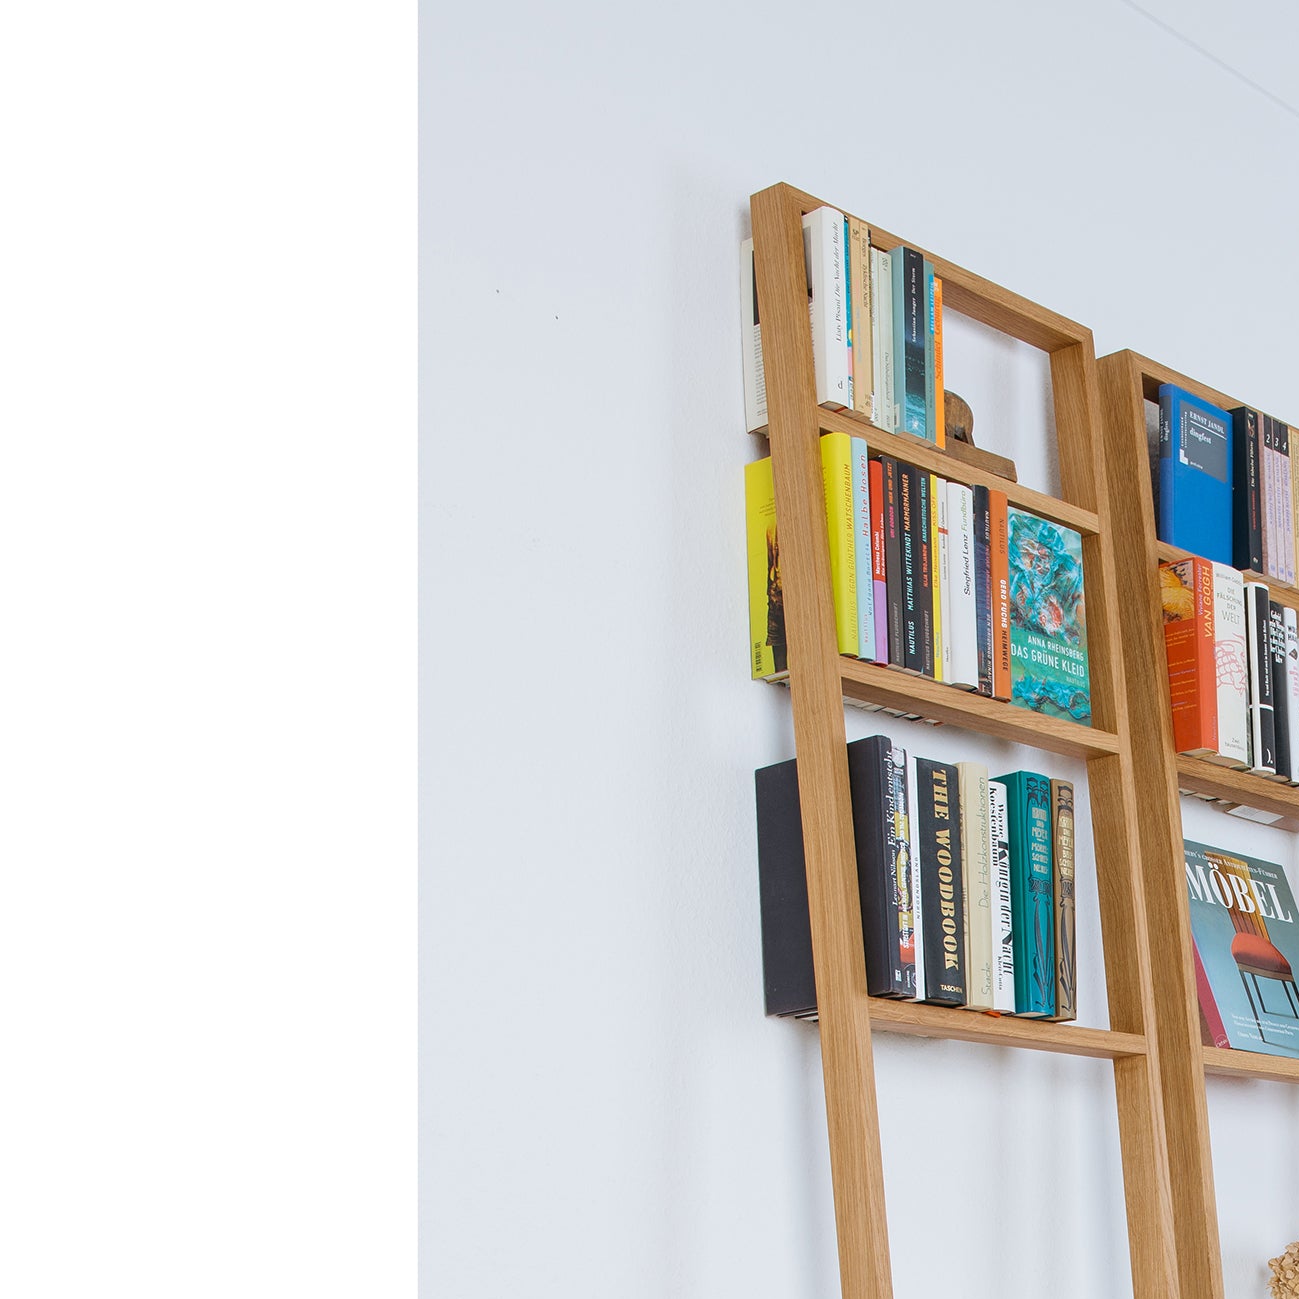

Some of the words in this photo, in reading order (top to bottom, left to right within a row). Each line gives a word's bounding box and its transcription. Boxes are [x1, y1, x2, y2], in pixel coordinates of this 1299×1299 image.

[833, 259, 841, 280] Nacht
[833, 284, 841, 297] Die
[1189, 411, 1207, 425] ERNST
[1207, 420, 1225, 434] JANDL
[1189, 427, 1211, 444] dingfest
[1266, 433, 1271, 443] 2
[1274, 437, 1279, 448] 3
[1282, 442, 1287, 451] 4
[844, 464, 853, 530] WATSCHENBAUM
[902, 474, 912, 531] MARMORMÄNNER
[959, 489, 968, 532] Fundbüro
[861, 499, 870, 537] Halbe
[905, 533, 914, 575] WITTEKINDT
[961, 533, 970, 555] Lenz
[962, 555, 972, 596] Siegfried
[1000, 579, 1008, 600] GERD
[1202, 566, 1211, 606] GOGH
[906, 577, 914, 611] MATTHIAS
[1226, 603, 1236, 611] DER
[1204, 610, 1213, 639] VAN
[1221, 610, 1240, 625] WELT
[908, 621, 916, 655] NAUTILUS
[1027, 635, 1046, 649] ANNA
[1047, 640, 1084, 662] RHEINSBERG
[1011, 644, 1028, 660] DAS
[1031, 647, 1059, 668] GRÜNE
[1061, 659, 1085, 678] KLEID
[883, 750, 894, 796] entsteht
[885, 797, 896, 824] Kind
[931, 769, 950, 821] THE
[887, 826, 897, 848] Ein
[976, 777, 989, 885] Holzkonstruktionen
[990, 787, 1000, 867] Koestenbaum
[996, 840, 1011, 903] Königin
[891, 877, 899, 906] Lennart
[935, 829, 960, 971] WOODBOOK
[978, 888, 989, 909] Die
[1184, 861, 1293, 923] MÖBEL
[1000, 905, 1011, 927] der
[1001, 927, 1014, 976] Nacht
[940, 984, 962, 994] TASCHEN
[982, 962, 992, 995] Stade
